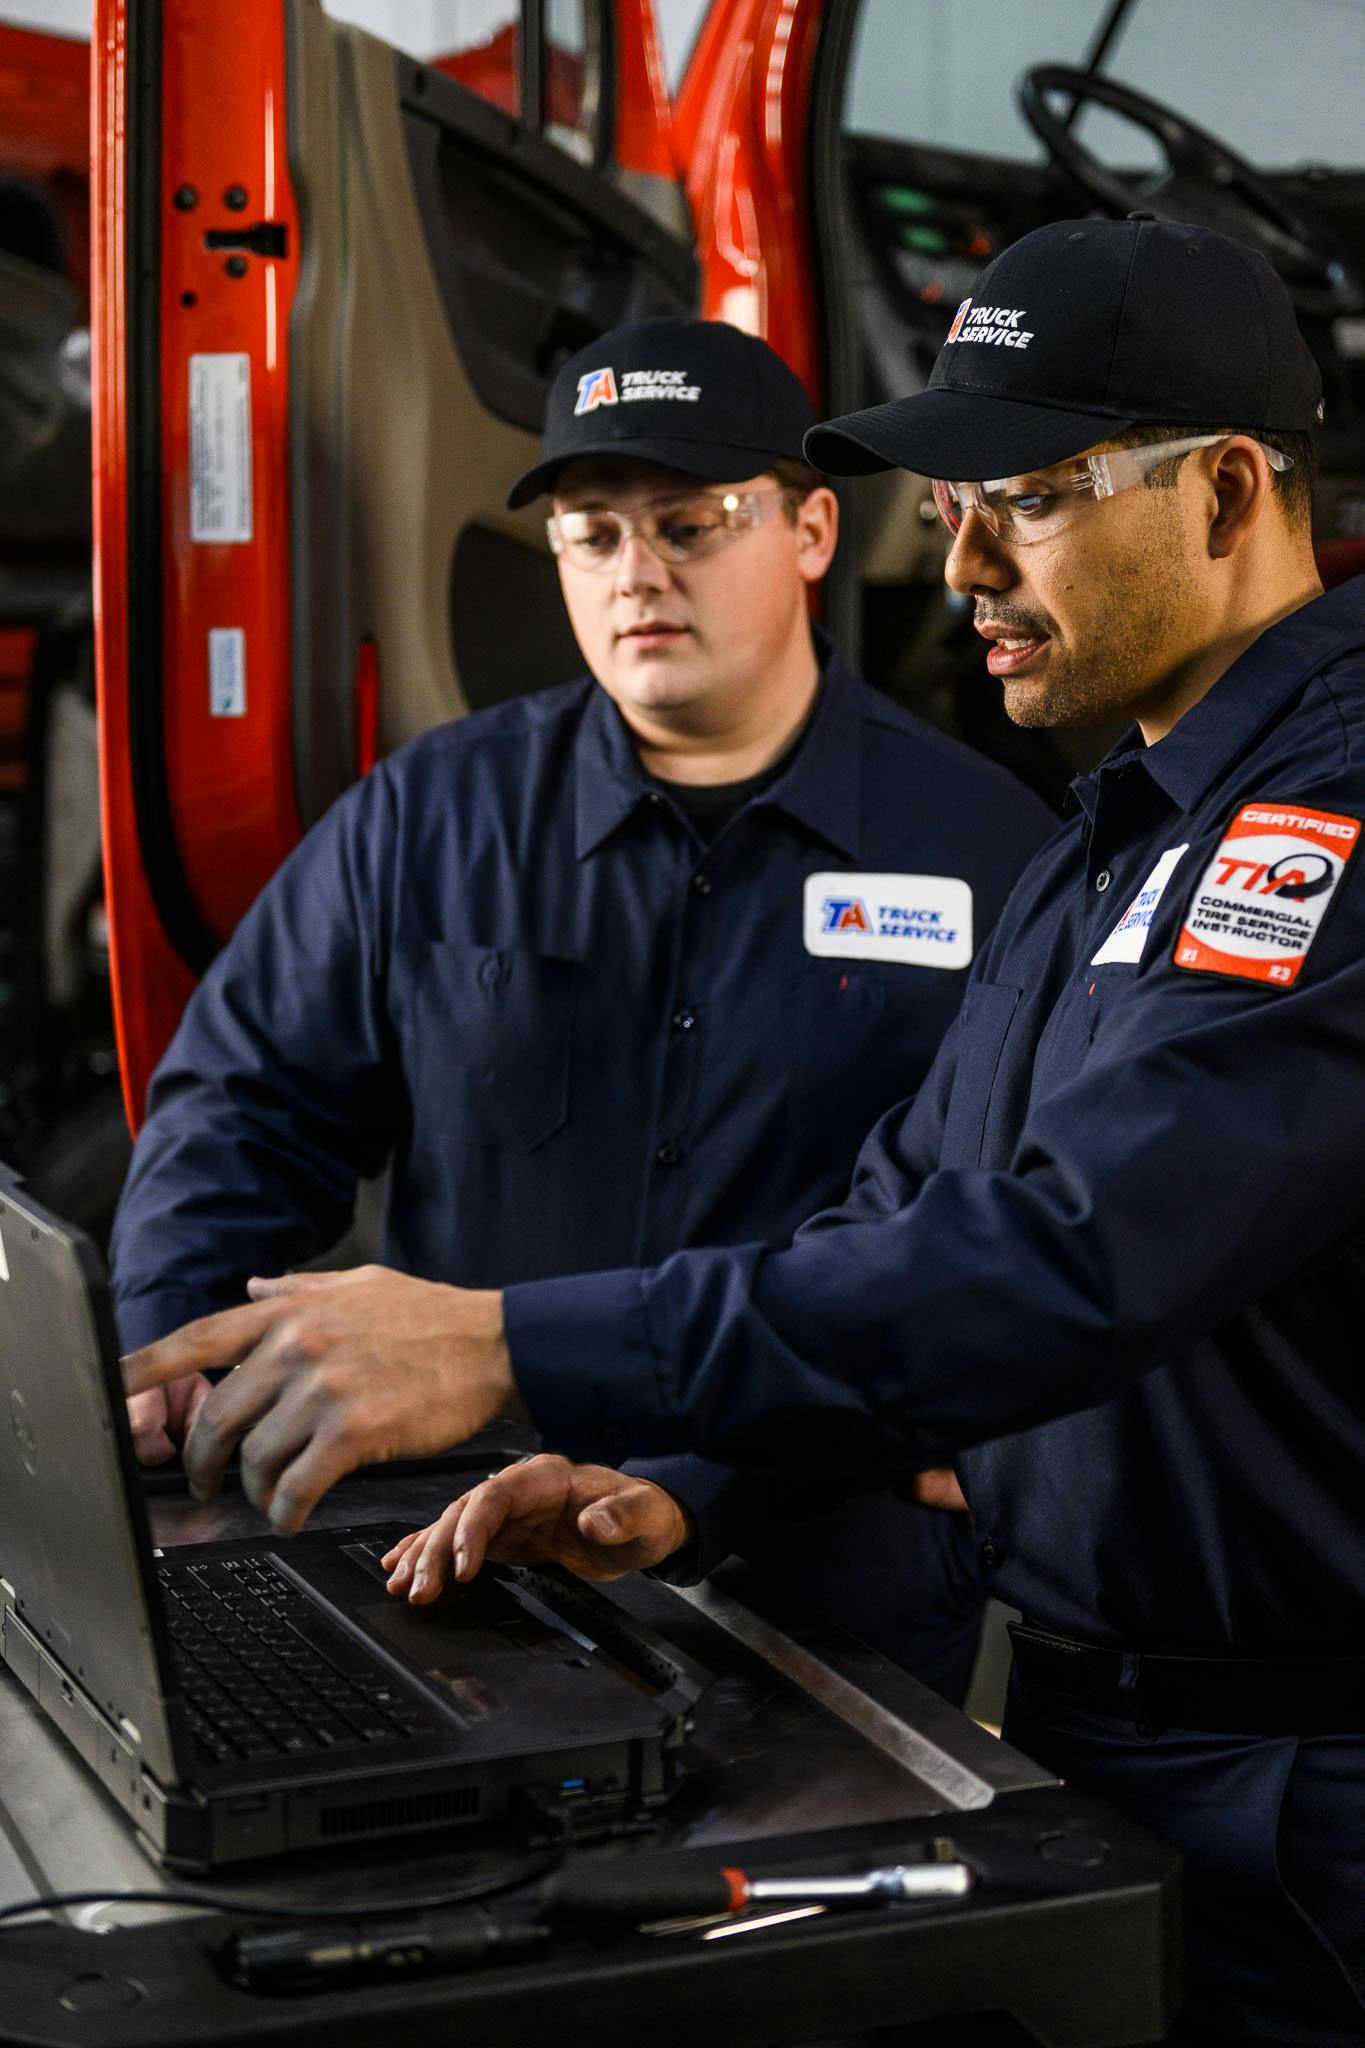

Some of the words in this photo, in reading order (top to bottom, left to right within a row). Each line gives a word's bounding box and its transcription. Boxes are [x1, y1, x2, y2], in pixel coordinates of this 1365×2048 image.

[966, 306, 1027, 328] TRUCK
[957, 326, 1035, 349] SERVICE
[621, 371, 687, 386] TRUCK
[574, 367, 619, 416] TA
[620, 385, 702, 402] SERVICE
[1240, 810, 1357, 840] CERTIFIED
[822, 896, 874, 935] TA
[878, 906, 942, 923] TRUCK
[1196, 908, 1233, 923] TIRE
[1236, 915, 1312, 940] SERVICE
[1199, 896, 1314, 929] COMMERCIAL
[879, 924, 957, 942] SERVICE
[1191, 919, 1304, 951] INSTRUCTOR
[1269, 963, 1292, 982] 23
